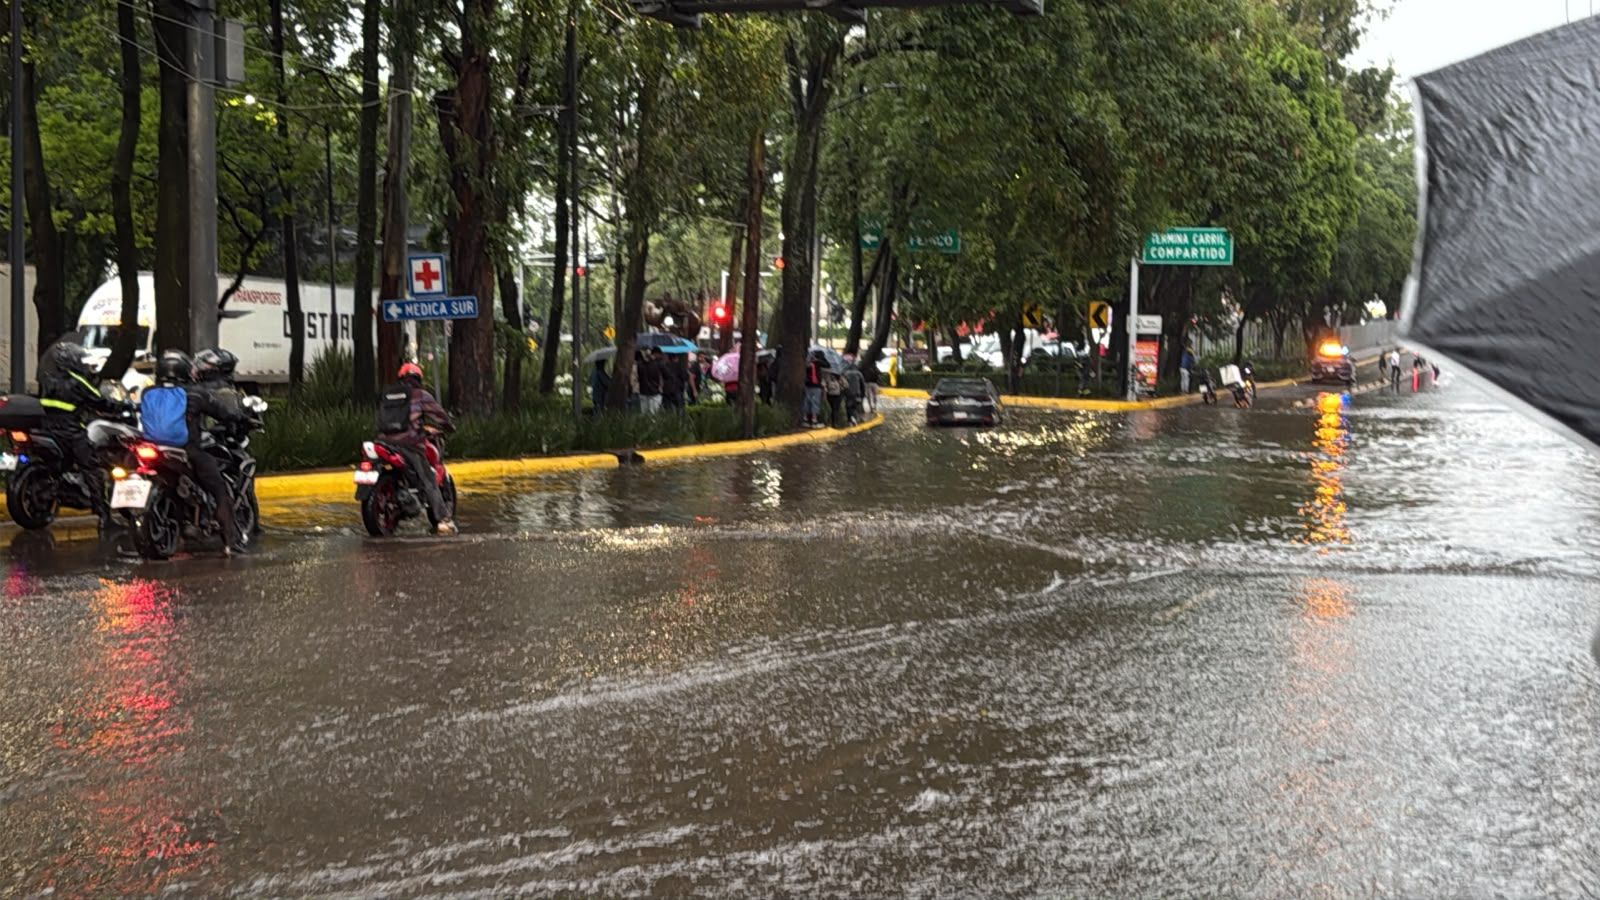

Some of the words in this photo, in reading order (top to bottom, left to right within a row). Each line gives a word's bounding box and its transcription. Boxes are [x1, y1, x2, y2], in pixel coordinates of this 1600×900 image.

[1192, 233, 1226, 246] CARRIL
[1150, 247, 1226, 260] COMPARTIDO
[404, 303, 448, 317] MEDICA
[451, 301, 474, 315] SUR
